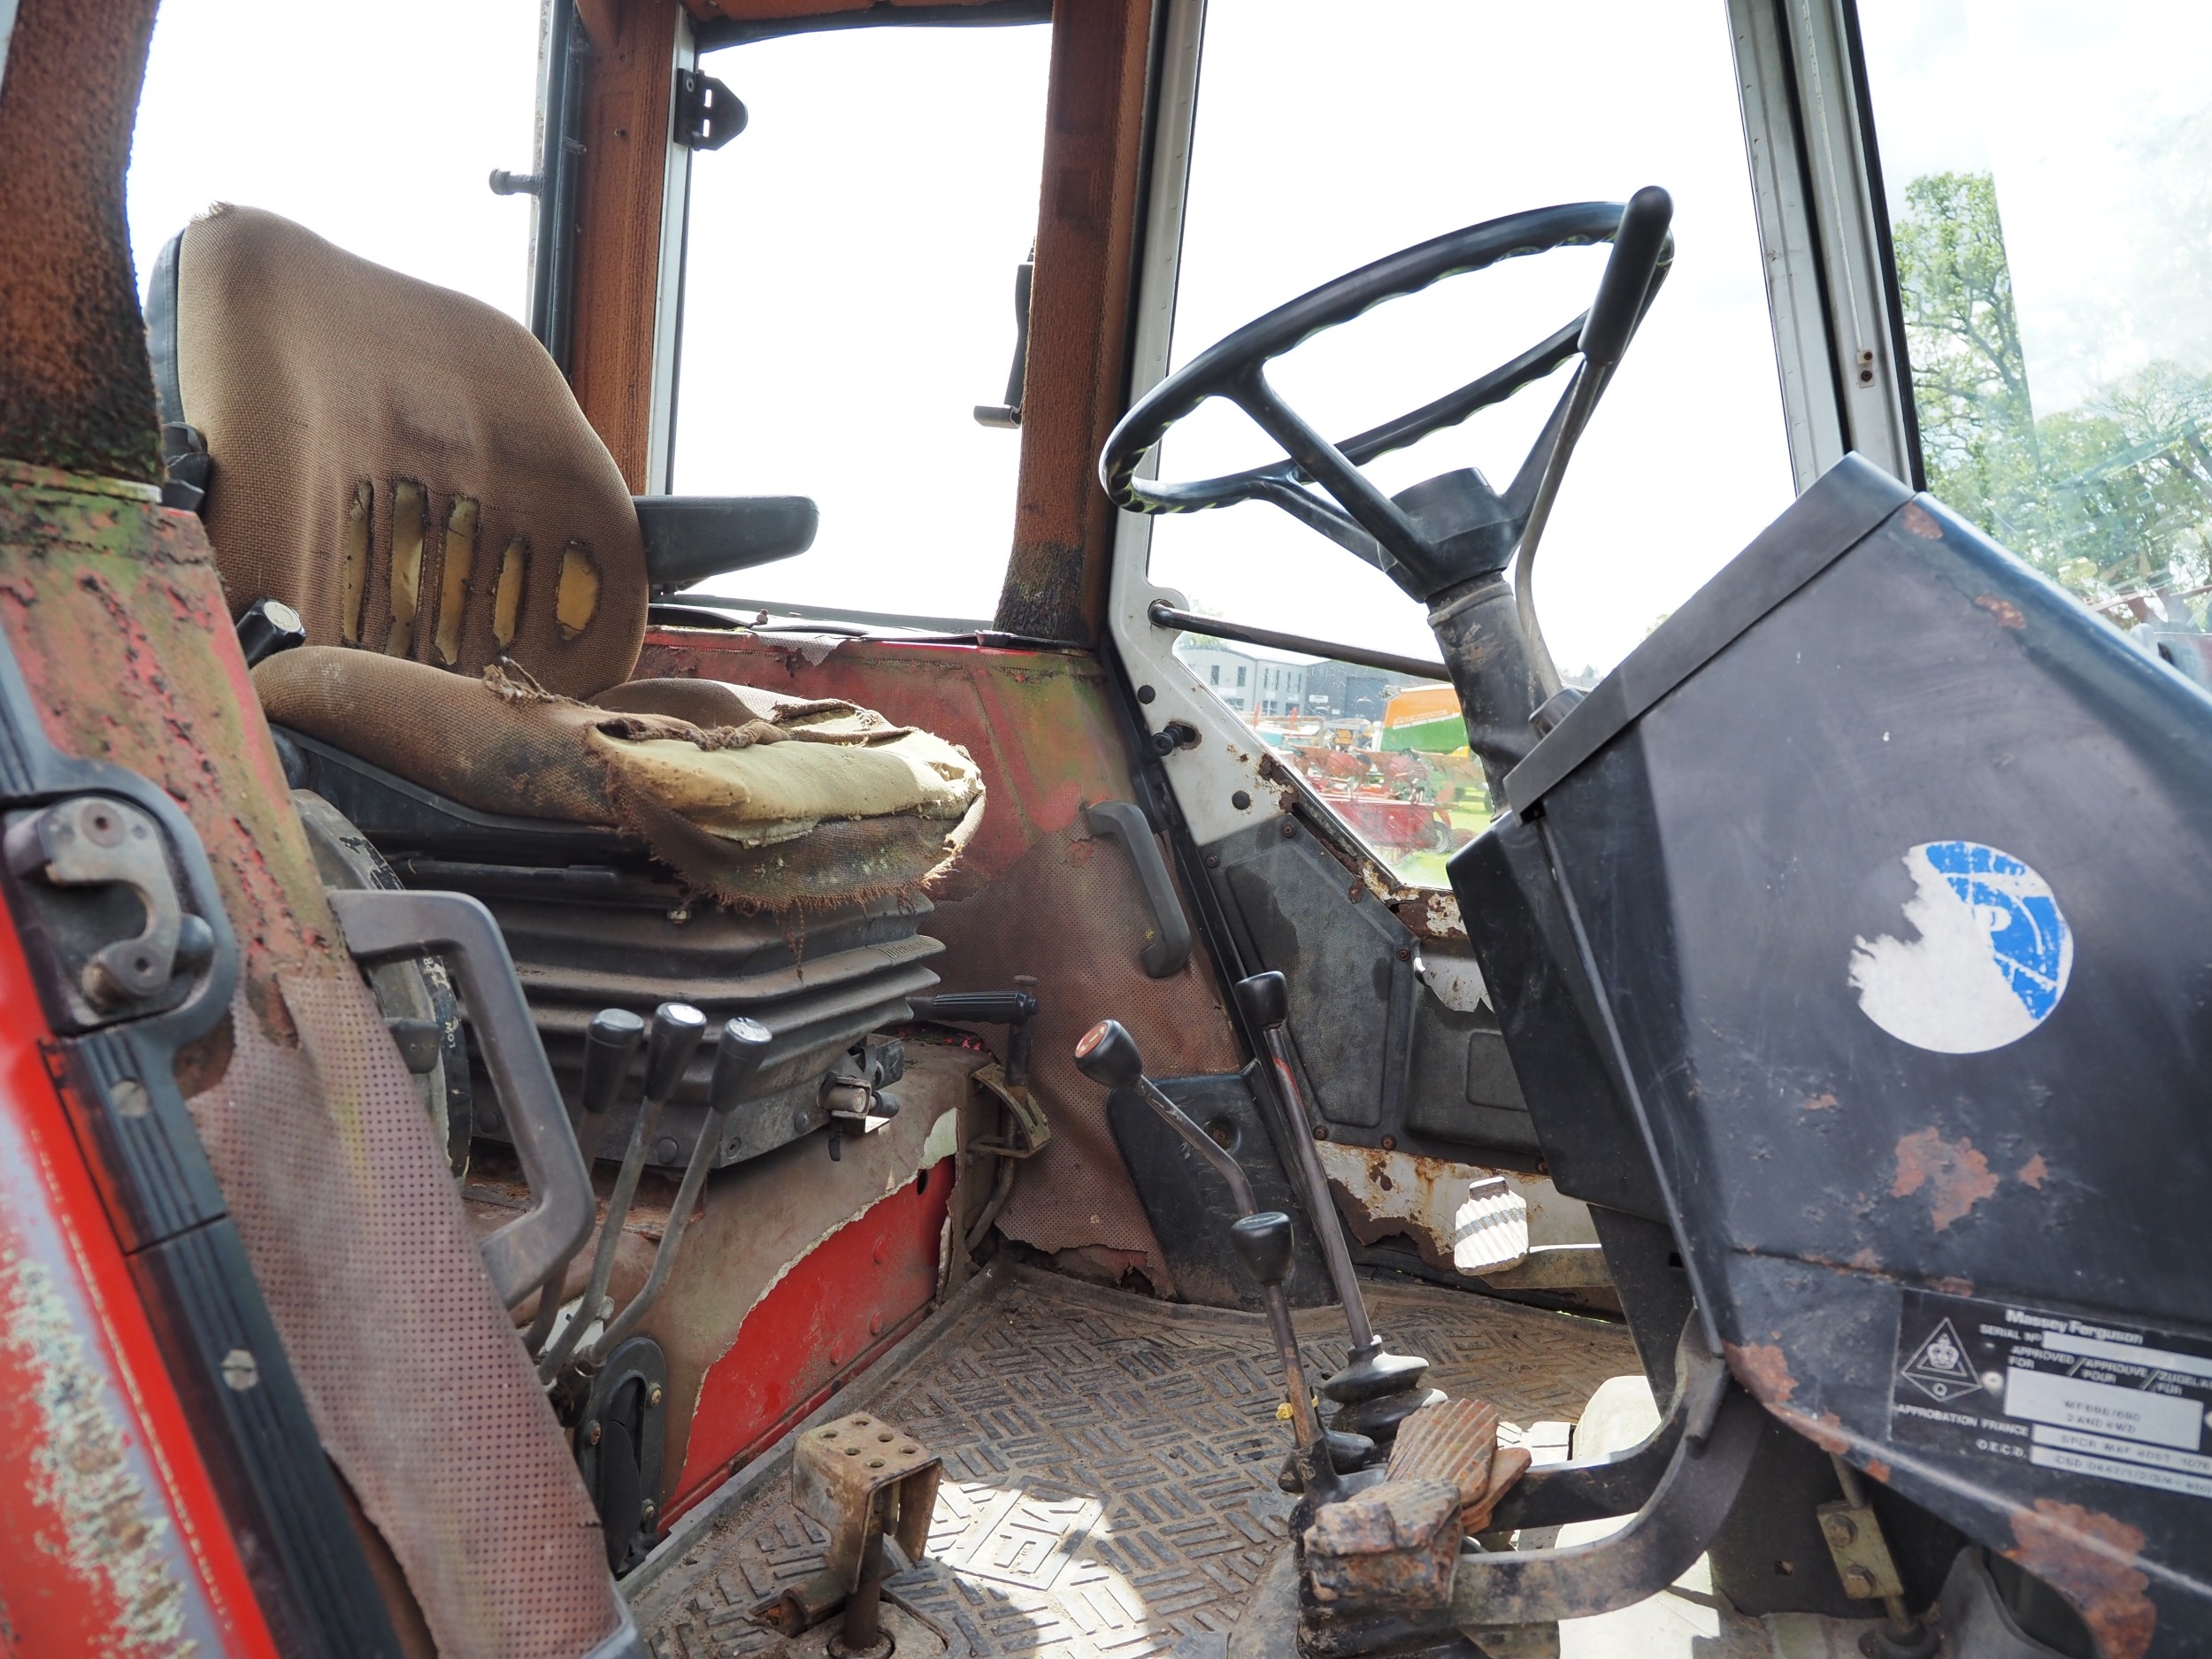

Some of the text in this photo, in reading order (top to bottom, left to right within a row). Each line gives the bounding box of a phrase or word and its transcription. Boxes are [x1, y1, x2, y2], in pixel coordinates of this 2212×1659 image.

[1979, 1324, 2021, 1340] SERIAL
[2005, 1310, 2143, 1345] Massey Ferguson
[2010, 1346, 2075, 1364] APPROVED
[2008, 1355, 2035, 1370] FOR
[2081, 1369, 2116, 1384] POUR
[1897, 1403, 2029, 1437] APPROBATION FRANCE
[2078, 1417, 2103, 1427] AND
